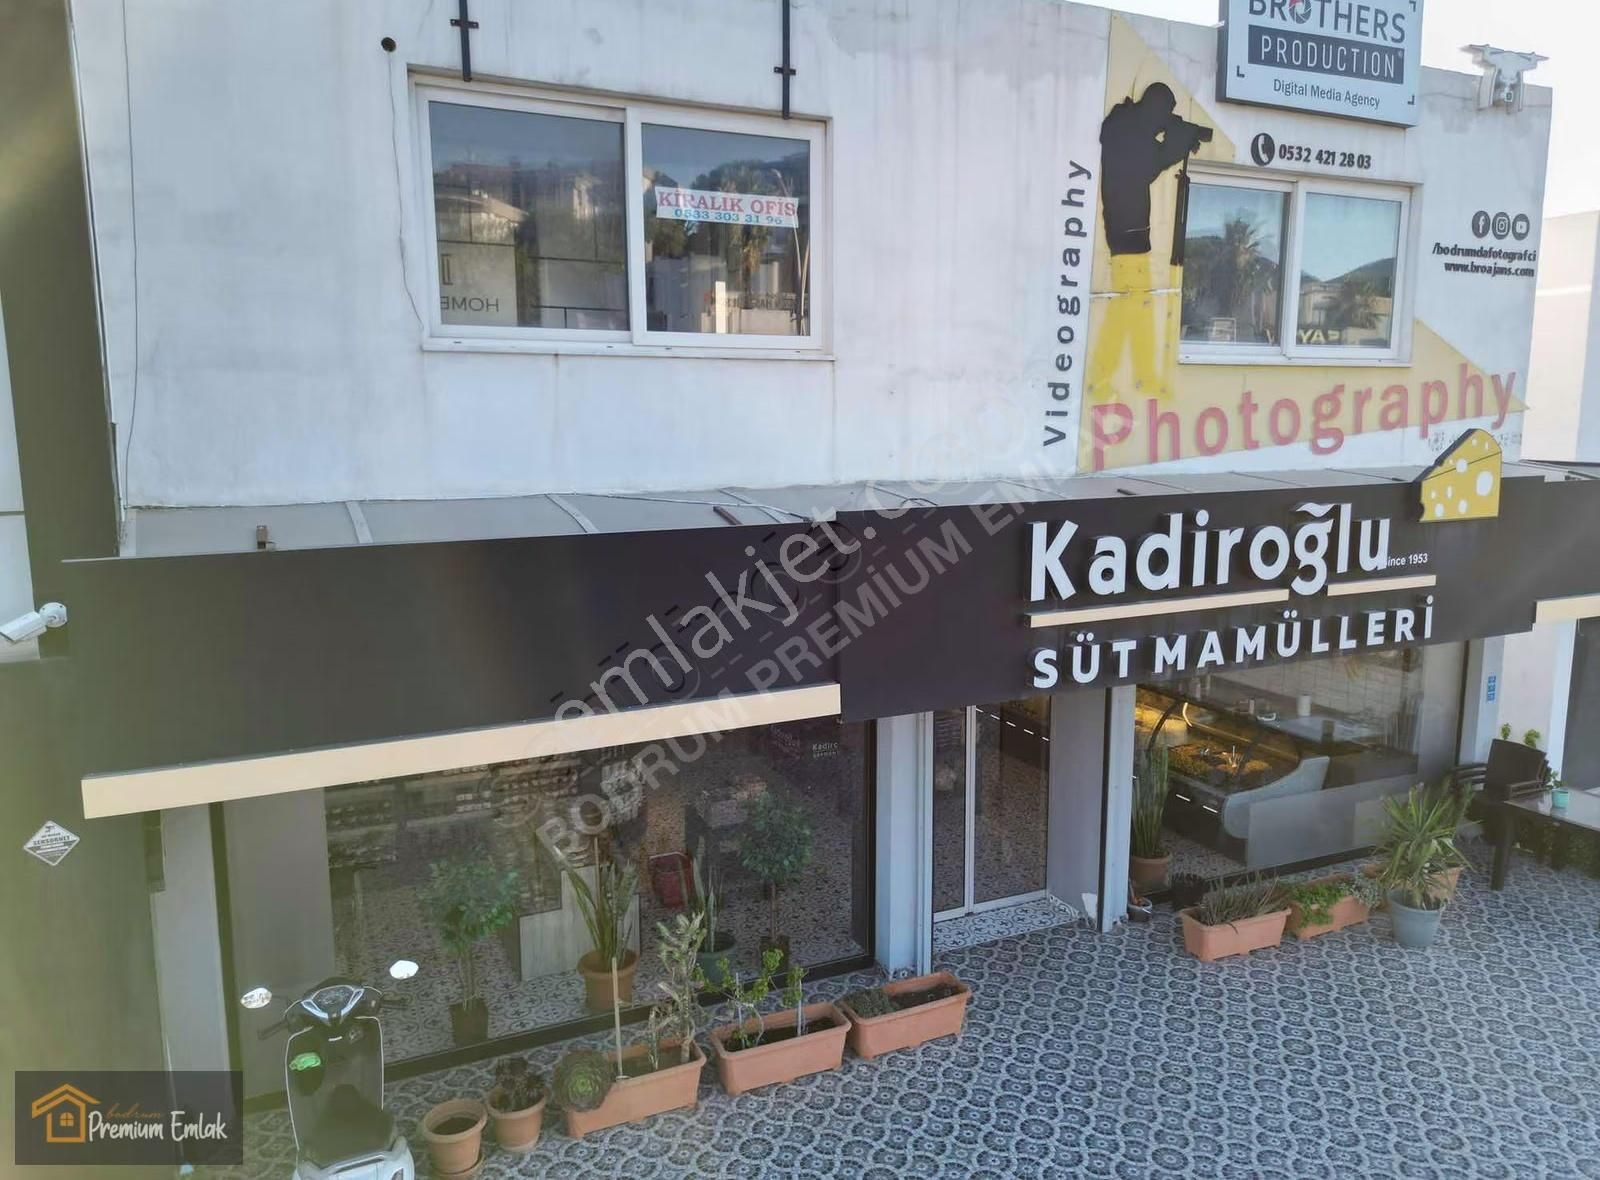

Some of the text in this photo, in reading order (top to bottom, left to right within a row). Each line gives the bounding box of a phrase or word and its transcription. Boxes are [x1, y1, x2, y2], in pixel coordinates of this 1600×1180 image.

[1261, 35, 1396, 79] PRODUCTION
[1273, 78, 1381, 109] Digital Media Agency
[1279, 144, 1372, 169] 0532 421 28 03
[714, 211, 741, 222] 303
[744, 214, 760, 223] 31
[750, 198, 796, 217] OFİS
[1444, 261, 1535, 277] www.broajans.com
[1043, 160, 1092, 447] videography
[1091, 363, 1516, 471] Photography
[1031, 503, 1390, 601] Kadiroğlu
[1387, 553, 1429, 567] ince 1953
